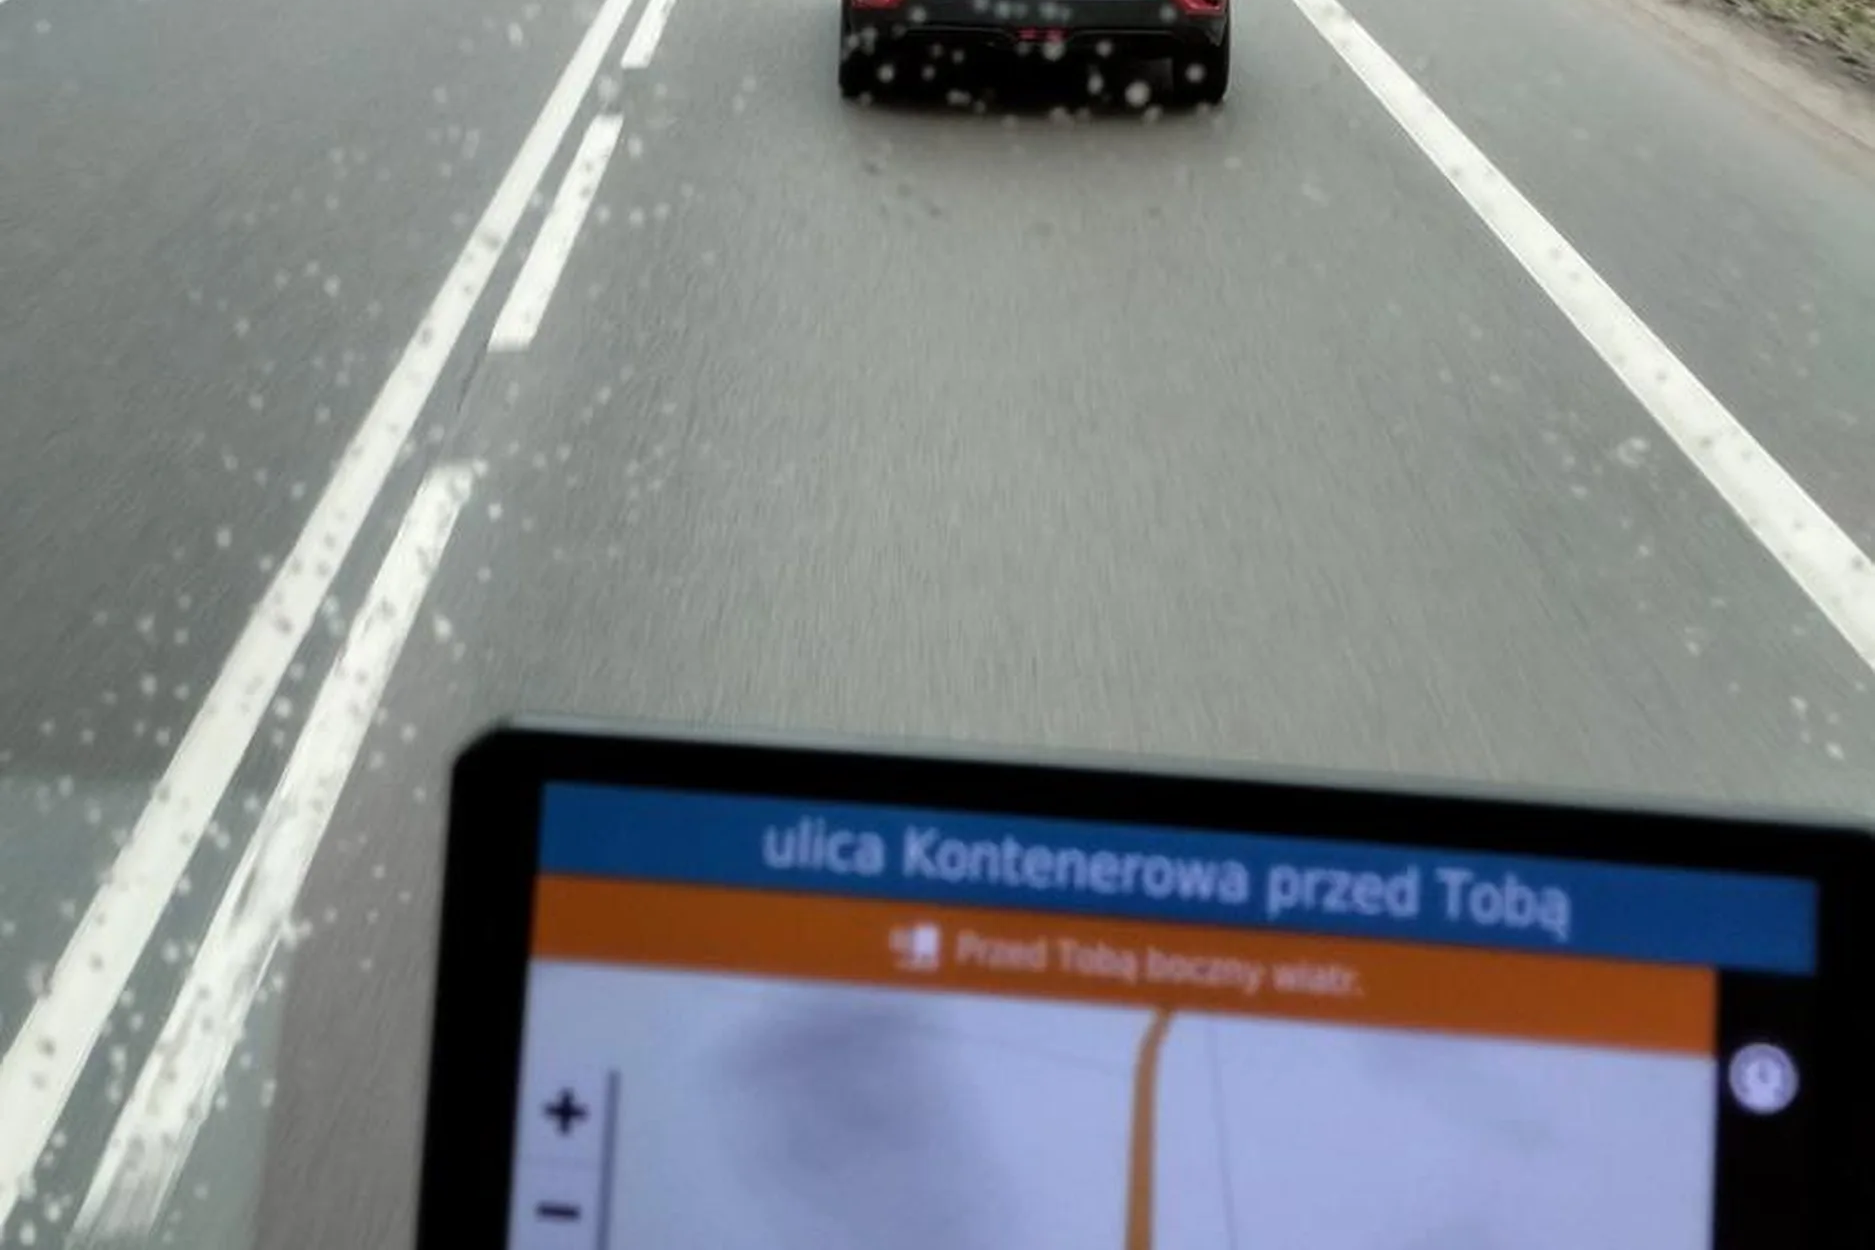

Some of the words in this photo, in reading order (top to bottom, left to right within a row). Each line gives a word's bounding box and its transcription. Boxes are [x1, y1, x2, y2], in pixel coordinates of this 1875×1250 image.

[763, 815, 886, 876] ulica
[903, 825, 1249, 904] Kontenerowa
[1267, 863, 1420, 921] przed
[1435, 866, 1572, 943] Tobą
[956, 929, 1048, 971] Przed
[1060, 937, 1138, 984] Tobą
[1146, 947, 1264, 996] boczny
